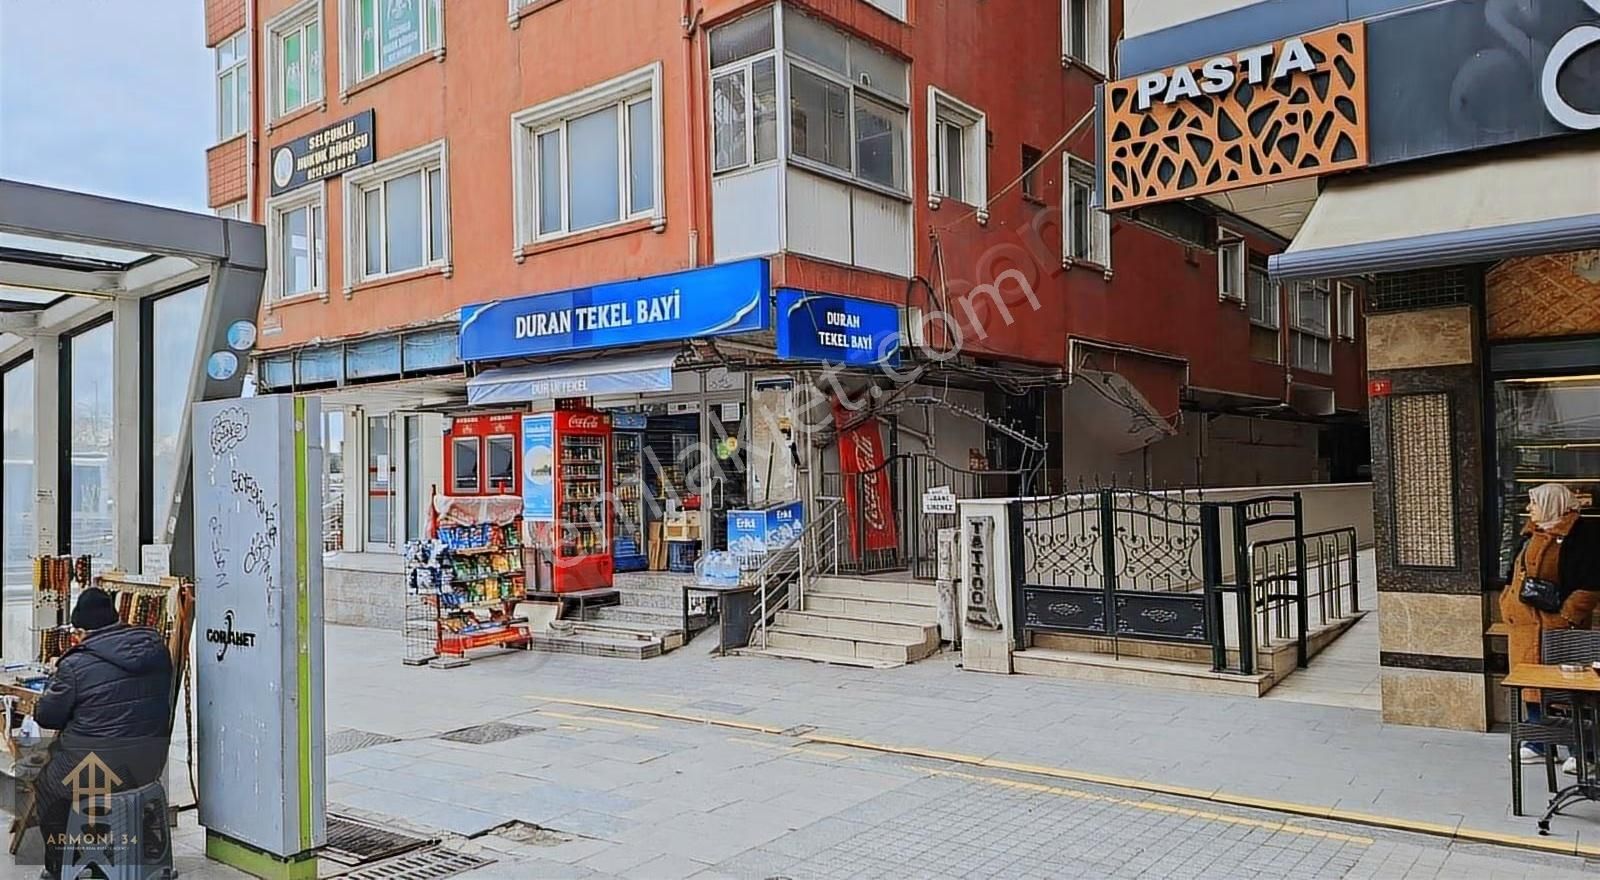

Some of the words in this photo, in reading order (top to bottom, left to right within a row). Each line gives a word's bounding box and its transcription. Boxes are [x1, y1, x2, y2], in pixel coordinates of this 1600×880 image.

[1137, 37, 1316, 110] PASTA
[515, 313, 572, 339] DURAN
[575, 303, 632, 331] TEKEL
[636, 288, 681, 325] BAYİ
[826, 311, 860, 329] DURAN
[818, 331, 850, 348] TEKEL
[851, 333, 873, 350] BAYİ
[561, 377, 588, 394] TEKEL
[970, 521, 984, 605] TATTOO
